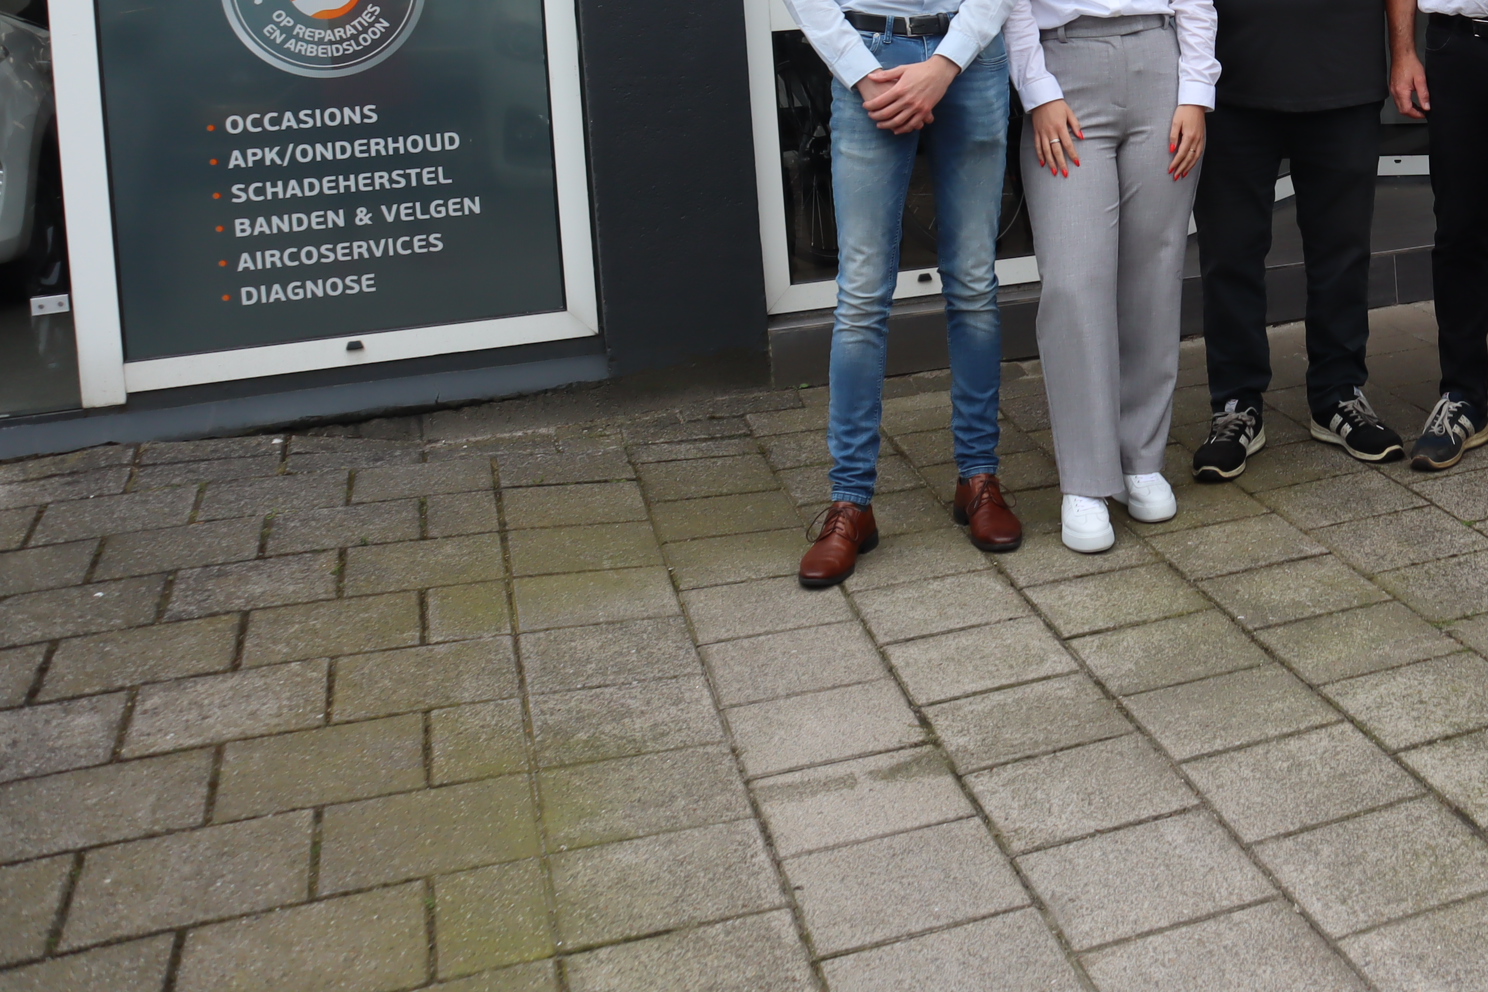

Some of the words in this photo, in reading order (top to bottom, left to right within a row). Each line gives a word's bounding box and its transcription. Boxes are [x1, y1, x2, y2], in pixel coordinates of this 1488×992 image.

[262, 23, 286, 45] EN
[283, 17, 391, 58] ARBEIDSLOON
[272, 9, 295, 28] OP
[293, 3, 381, 42] REPARATIES
[225, 104, 379, 134] OCCASIONS
[227, 131, 460, 169] APK/ONDERHOUD
[231, 166, 453, 203] SCHADEHERSTEL
[234, 209, 345, 238] BANDEN
[354, 206, 373, 226] &
[380, 196, 481, 223] VELGEN
[236, 233, 444, 272] AIRCOSERVICES
[240, 273, 377, 306] DIAGNOSE
